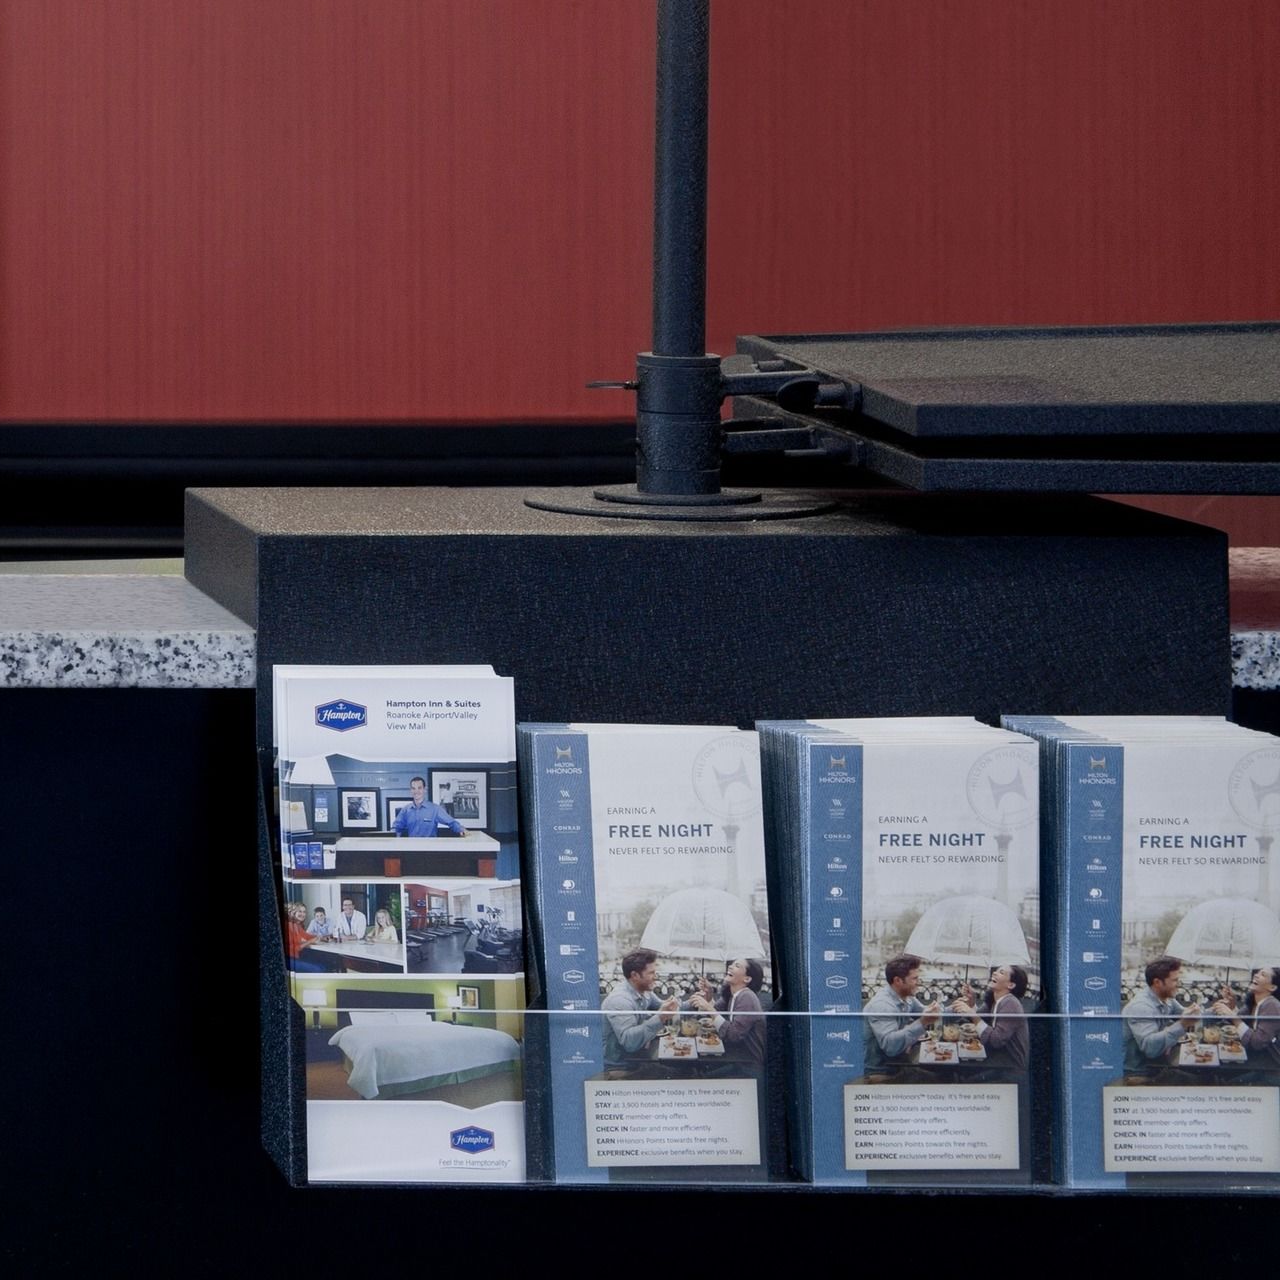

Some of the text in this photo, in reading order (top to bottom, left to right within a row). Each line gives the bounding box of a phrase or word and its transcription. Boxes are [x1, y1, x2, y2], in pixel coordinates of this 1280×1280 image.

[386, 700, 426, 709] Hampton
[317, 709, 365, 722] Hampton
[423, 711, 478, 720] Airport/Valley
[409, 722, 426, 730] Mall
[607, 807, 648, 815] EARNING
[878, 816, 920, 824] EARNING
[609, 824, 713, 838] FREE NIGHT
[880, 833, 985, 847] FREE NIGHT
[1140, 835, 1247, 848] FREE NIGHT
[609, 848, 638, 856] NEVER
[663, 847, 676, 855] SO
[1139, 857, 1169, 865] NEVER
[594, 1089, 611, 1097] JOIN
[612, 1089, 631, 1097] Hilton
[698, 1088, 711, 1096] free
[712, 1088, 724, 1096] and
[854, 1093, 870, 1101] JOIN
[871, 1093, 891, 1101] Hilton
[1113, 1095, 1129, 1103] JOIN
[595, 1101, 611, 1109] STAY
[661, 1100, 673, 1108] and
[674, 1100, 696, 1108] resorts
[854, 1105, 870, 1113] STAY
[595, 1113, 624, 1121] RECEIVE
[1114, 1118, 1142, 1126] RECEIVE
[596, 1125, 619, 1133] CHECK
[649, 1124, 661, 1132] and
[854, 1128, 878, 1136] CHECK
[879, 1128, 887, 1136] IN
[888, 1128, 906, 1136] faster
[908, 1128, 920, 1136] and
[452, 1135, 493, 1145] Hampton
[596, 1137, 615, 1145] EARN
[646, 1136, 665, 1144] Points
[667, 1136, 693, 1144] towards
[694, 1136, 706, 1144] free
[855, 1140, 873, 1148] EARN
[904, 1140, 924, 1148] Points
[925, 1140, 952, 1148] towards
[953, 1140, 965, 1148] free
[597, 1149, 639, 1157] EXPERIENCE
[641, 1148, 669, 1156] exclusive
[670, 1148, 696, 1156] benefits
[716, 1149, 728, 1157] you
[855, 1152, 897, 1160] EXPERIENCE
[898, 1152, 927, 1160] exclusive
[929, 1152, 954, 1160] benefits
[956, 1152, 973, 1160] when
[975, 1153, 987, 1161] you
